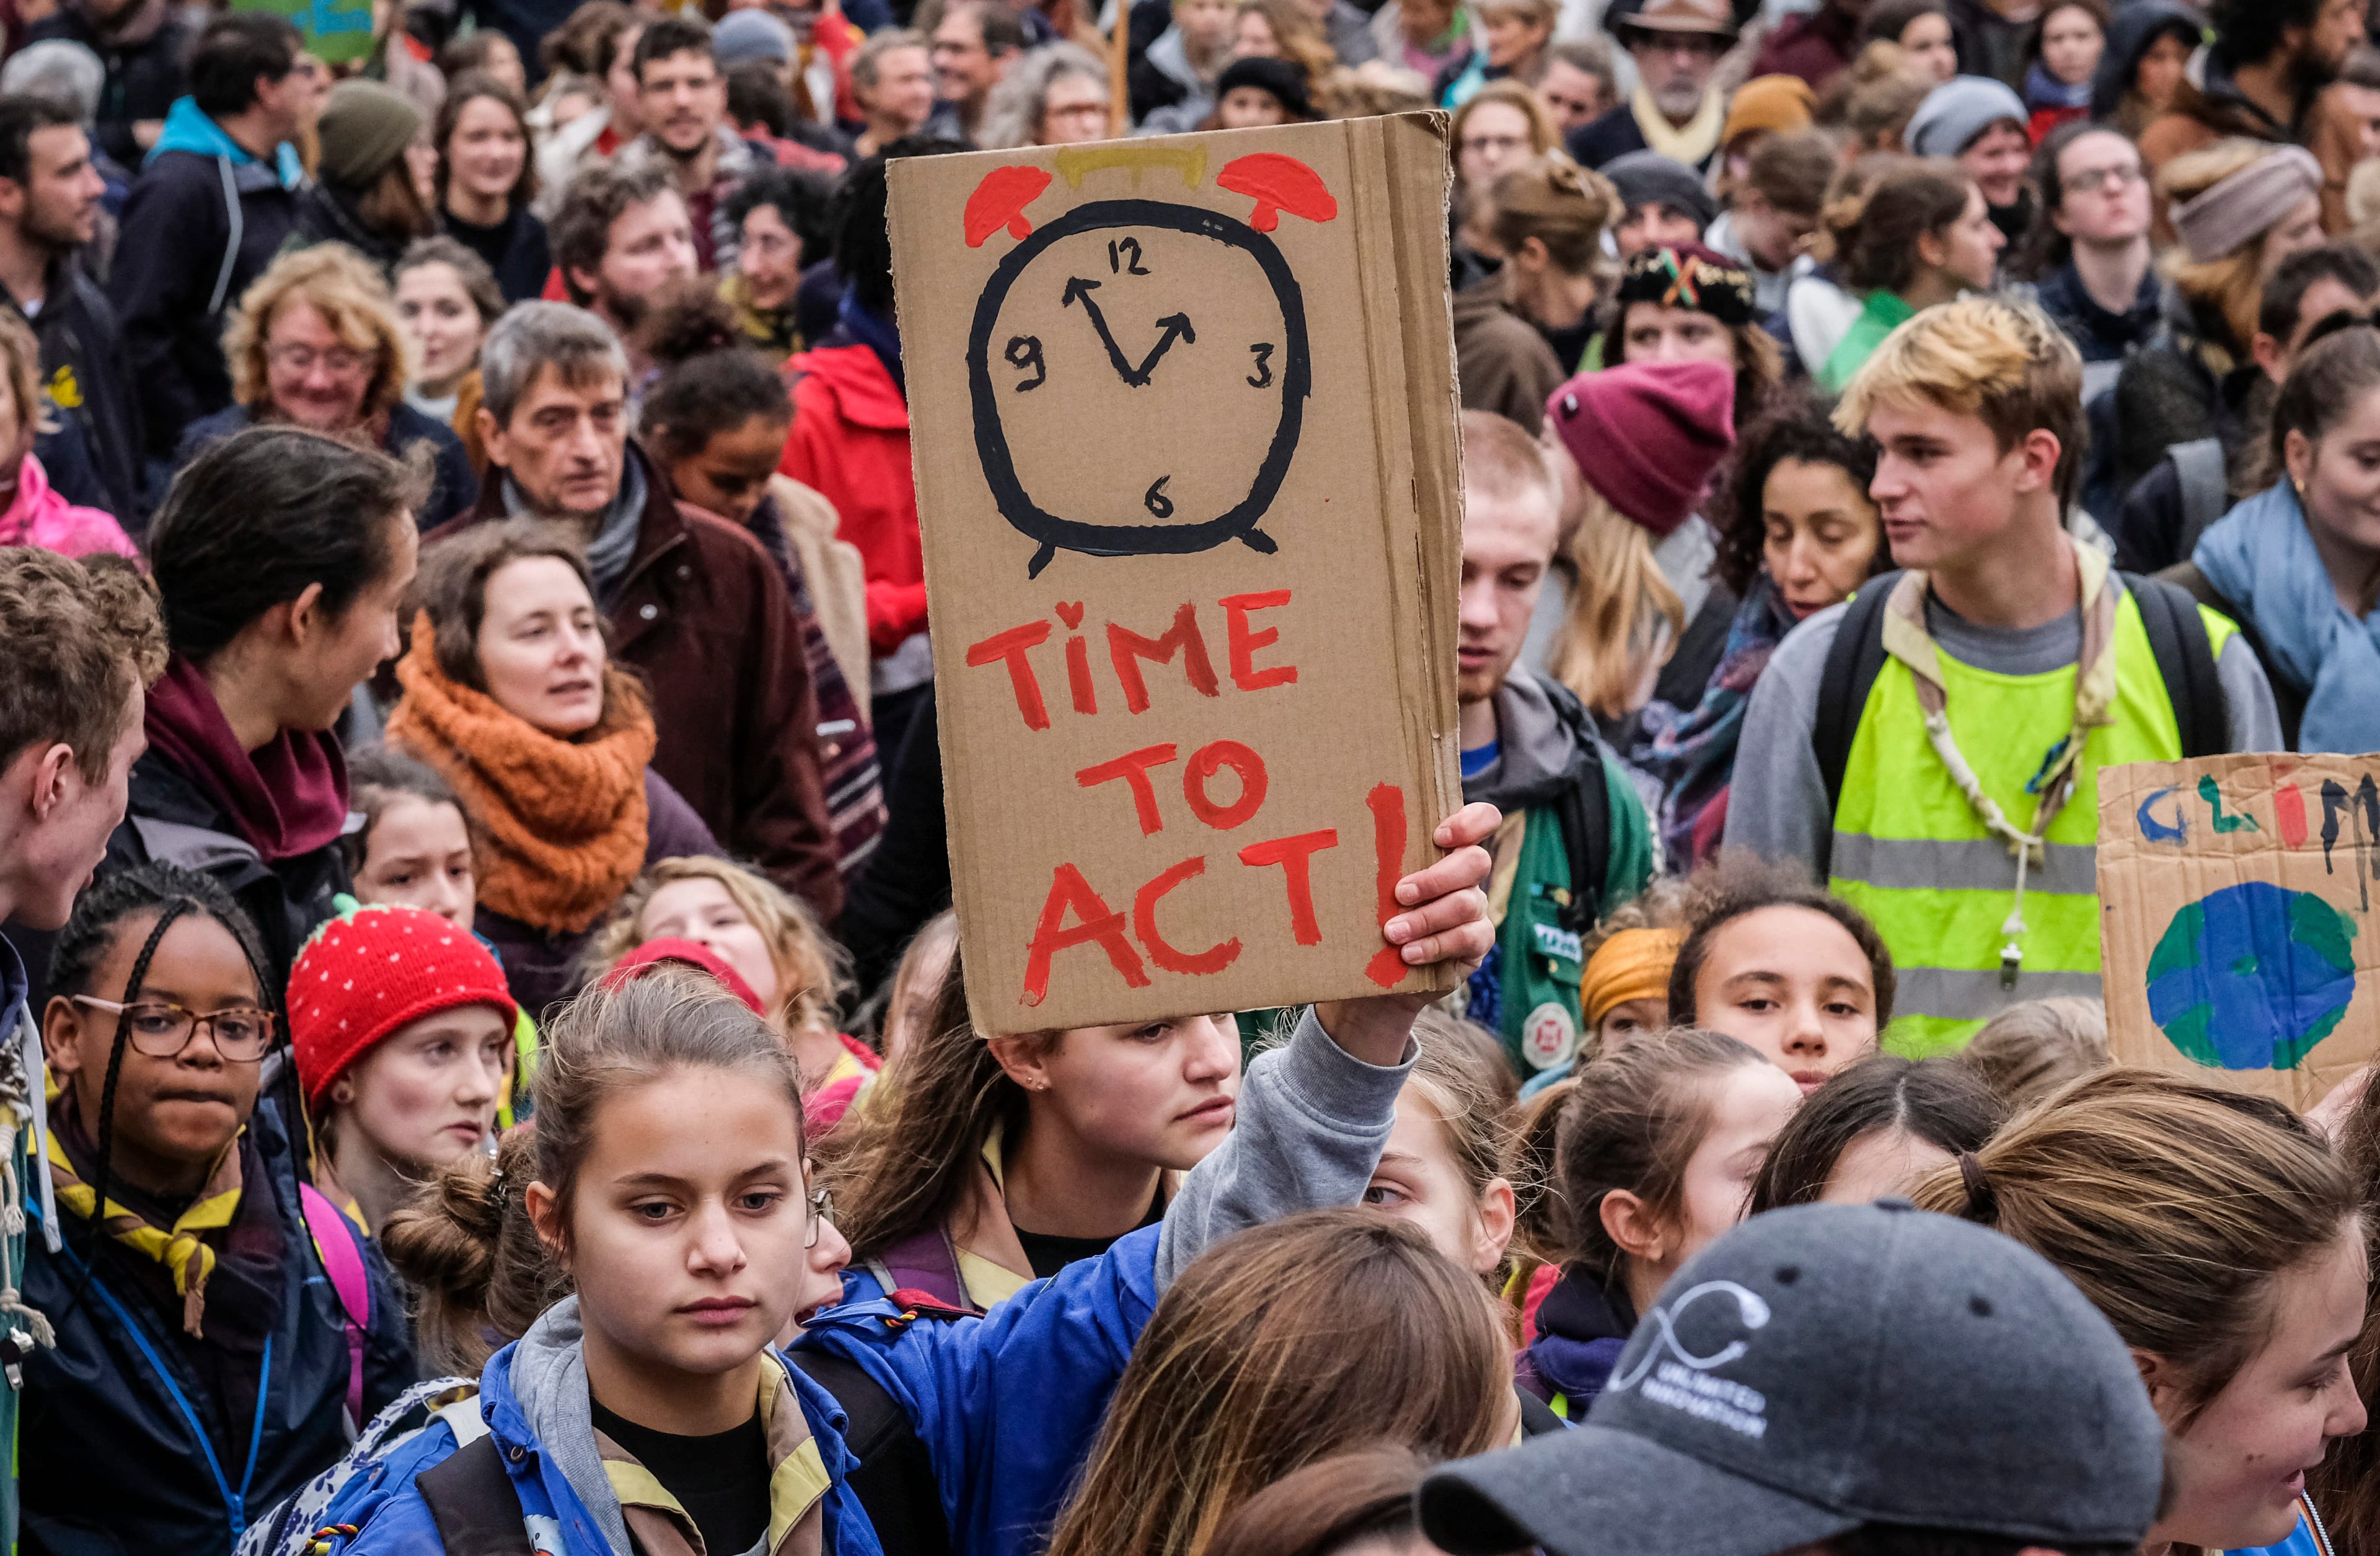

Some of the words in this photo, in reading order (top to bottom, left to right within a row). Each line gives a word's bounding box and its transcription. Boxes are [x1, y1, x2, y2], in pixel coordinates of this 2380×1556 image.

[1108, 234, 1151, 275] 12
[1004, 335, 1046, 392] 9
[1246, 342, 1275, 389] 3
[1144, 475, 1175, 518] 6
[1075, 740, 1269, 838] TO
[1018, 781, 1408, 1008] ACT!
